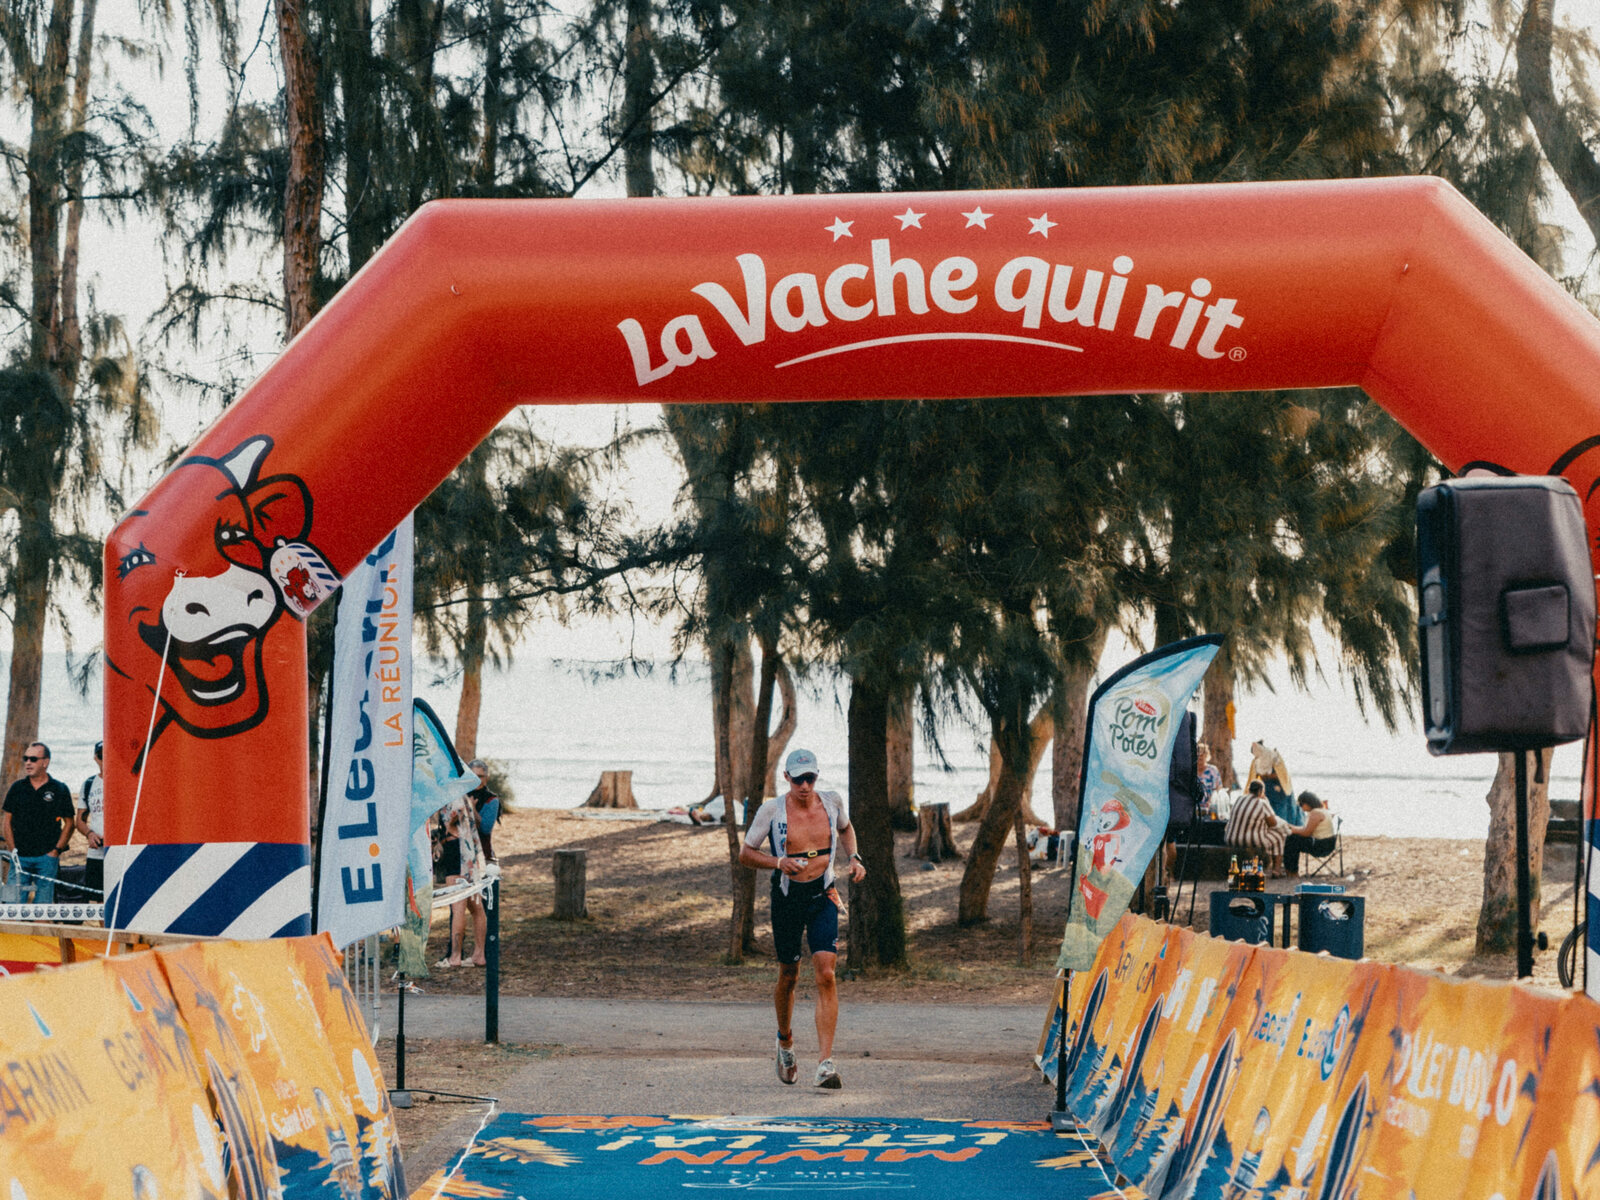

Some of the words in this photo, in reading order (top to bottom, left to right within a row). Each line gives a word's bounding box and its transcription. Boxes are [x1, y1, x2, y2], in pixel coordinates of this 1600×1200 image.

[616, 313, 718, 387] La
[691, 237, 979, 348] Vache
[994, 254, 1135, 332] qui
[1133, 276, 1246, 361] rit
[384, 711, 404, 747] LA
[1109, 724, 1158, 760] Potes
[636, 1147, 983, 1165] MWIN
